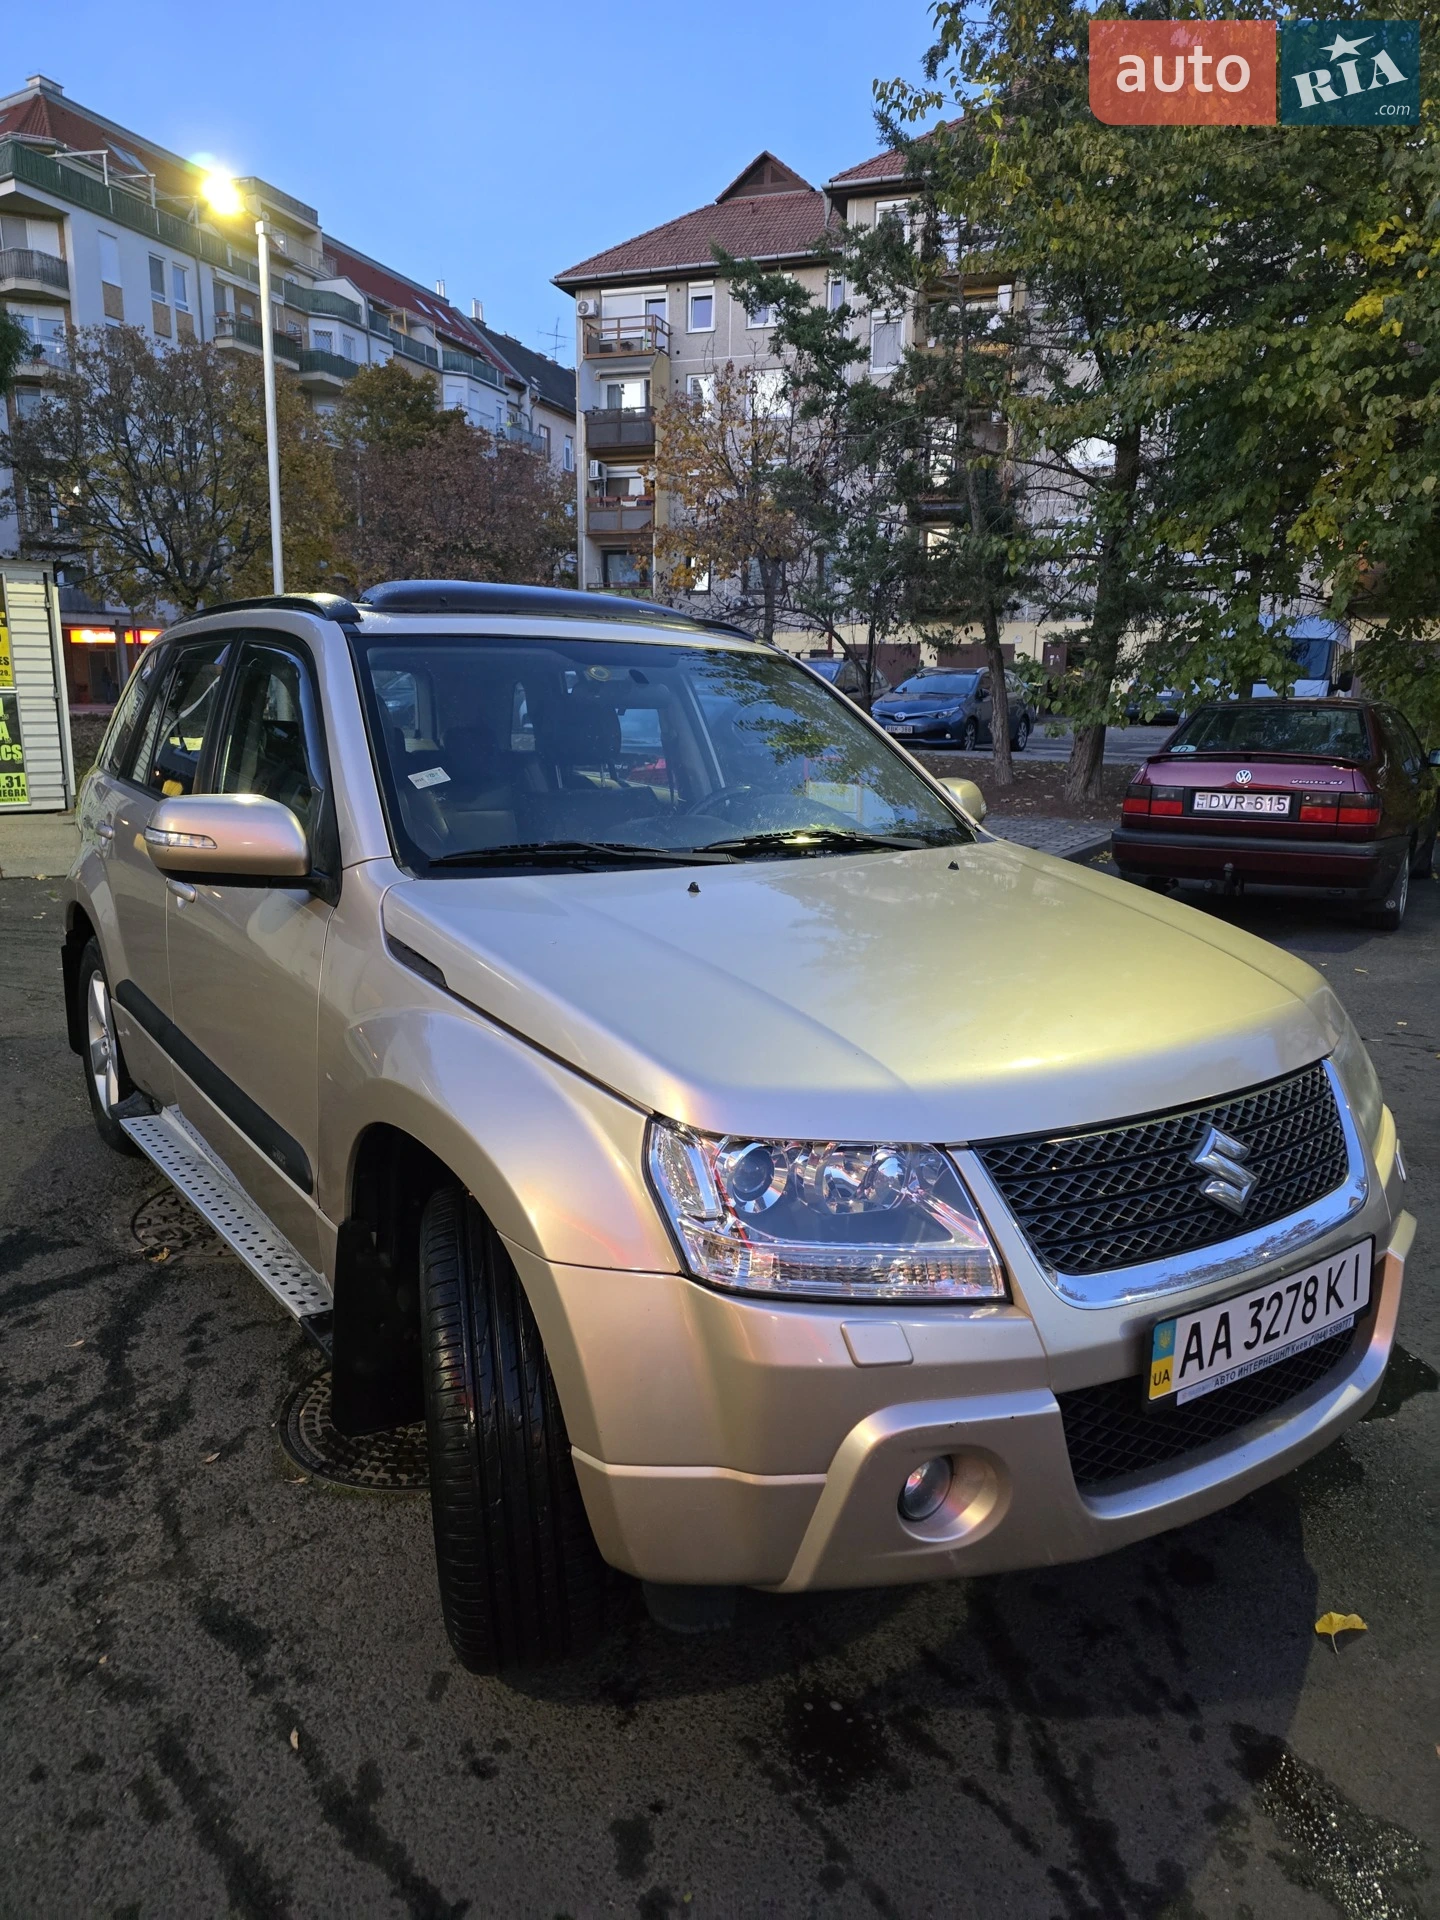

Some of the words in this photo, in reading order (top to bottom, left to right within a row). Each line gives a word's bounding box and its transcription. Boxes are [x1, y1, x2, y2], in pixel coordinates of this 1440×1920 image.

[1209, 795, 1288, 811] DVR-615
[1179, 1312, 1232, 1378] AA
[1243, 1275, 1319, 1350] 3278
[1152, 1369, 1171, 1386] UA
